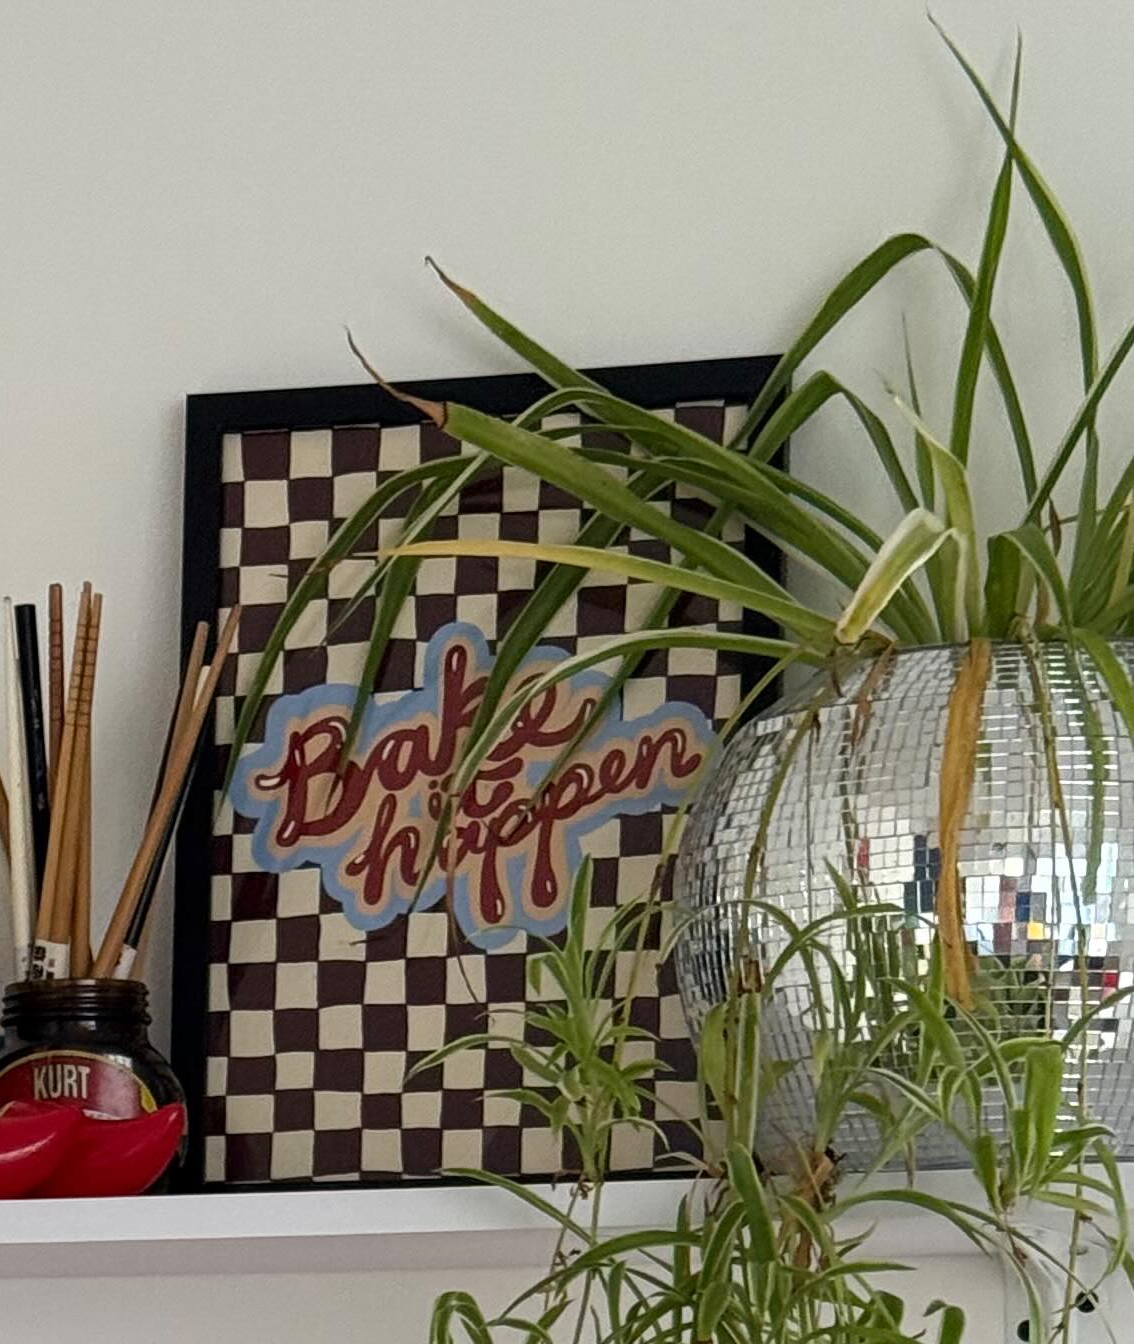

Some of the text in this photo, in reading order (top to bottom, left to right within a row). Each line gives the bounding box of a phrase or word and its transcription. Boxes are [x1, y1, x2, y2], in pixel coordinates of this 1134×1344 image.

[255, 644, 596, 847] Bake
[345, 727, 702, 925] happen
[33, 1065, 91, 1100] KURT
